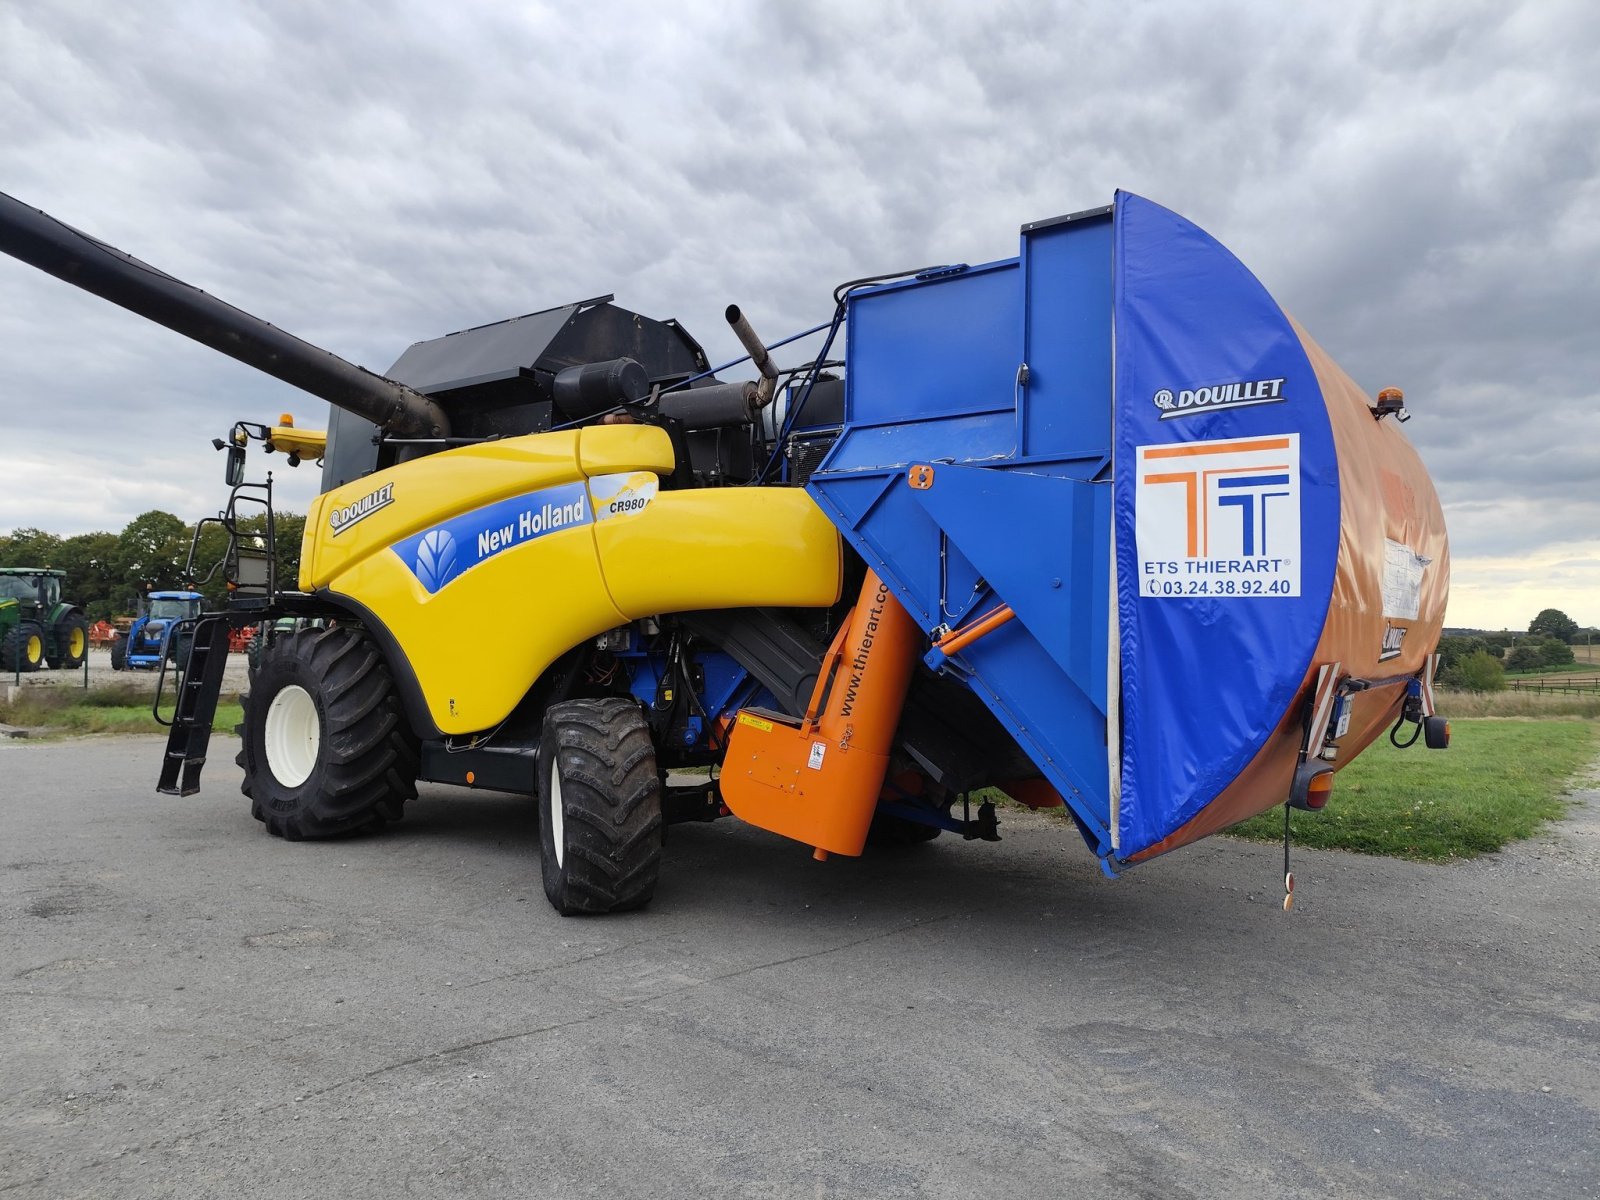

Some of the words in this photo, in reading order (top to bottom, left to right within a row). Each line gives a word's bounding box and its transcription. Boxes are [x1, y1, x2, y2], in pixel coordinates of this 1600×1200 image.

[1178, 378, 1285, 408] DOUILLET
[341, 482, 393, 523] DOUILLET
[610, 497, 651, 513] CR980
[478, 523, 515, 558] New
[519, 495, 584, 538] Holland
[1145, 561, 1179, 574] ETS
[1163, 580, 1291, 595] 03.24.38.92.40
